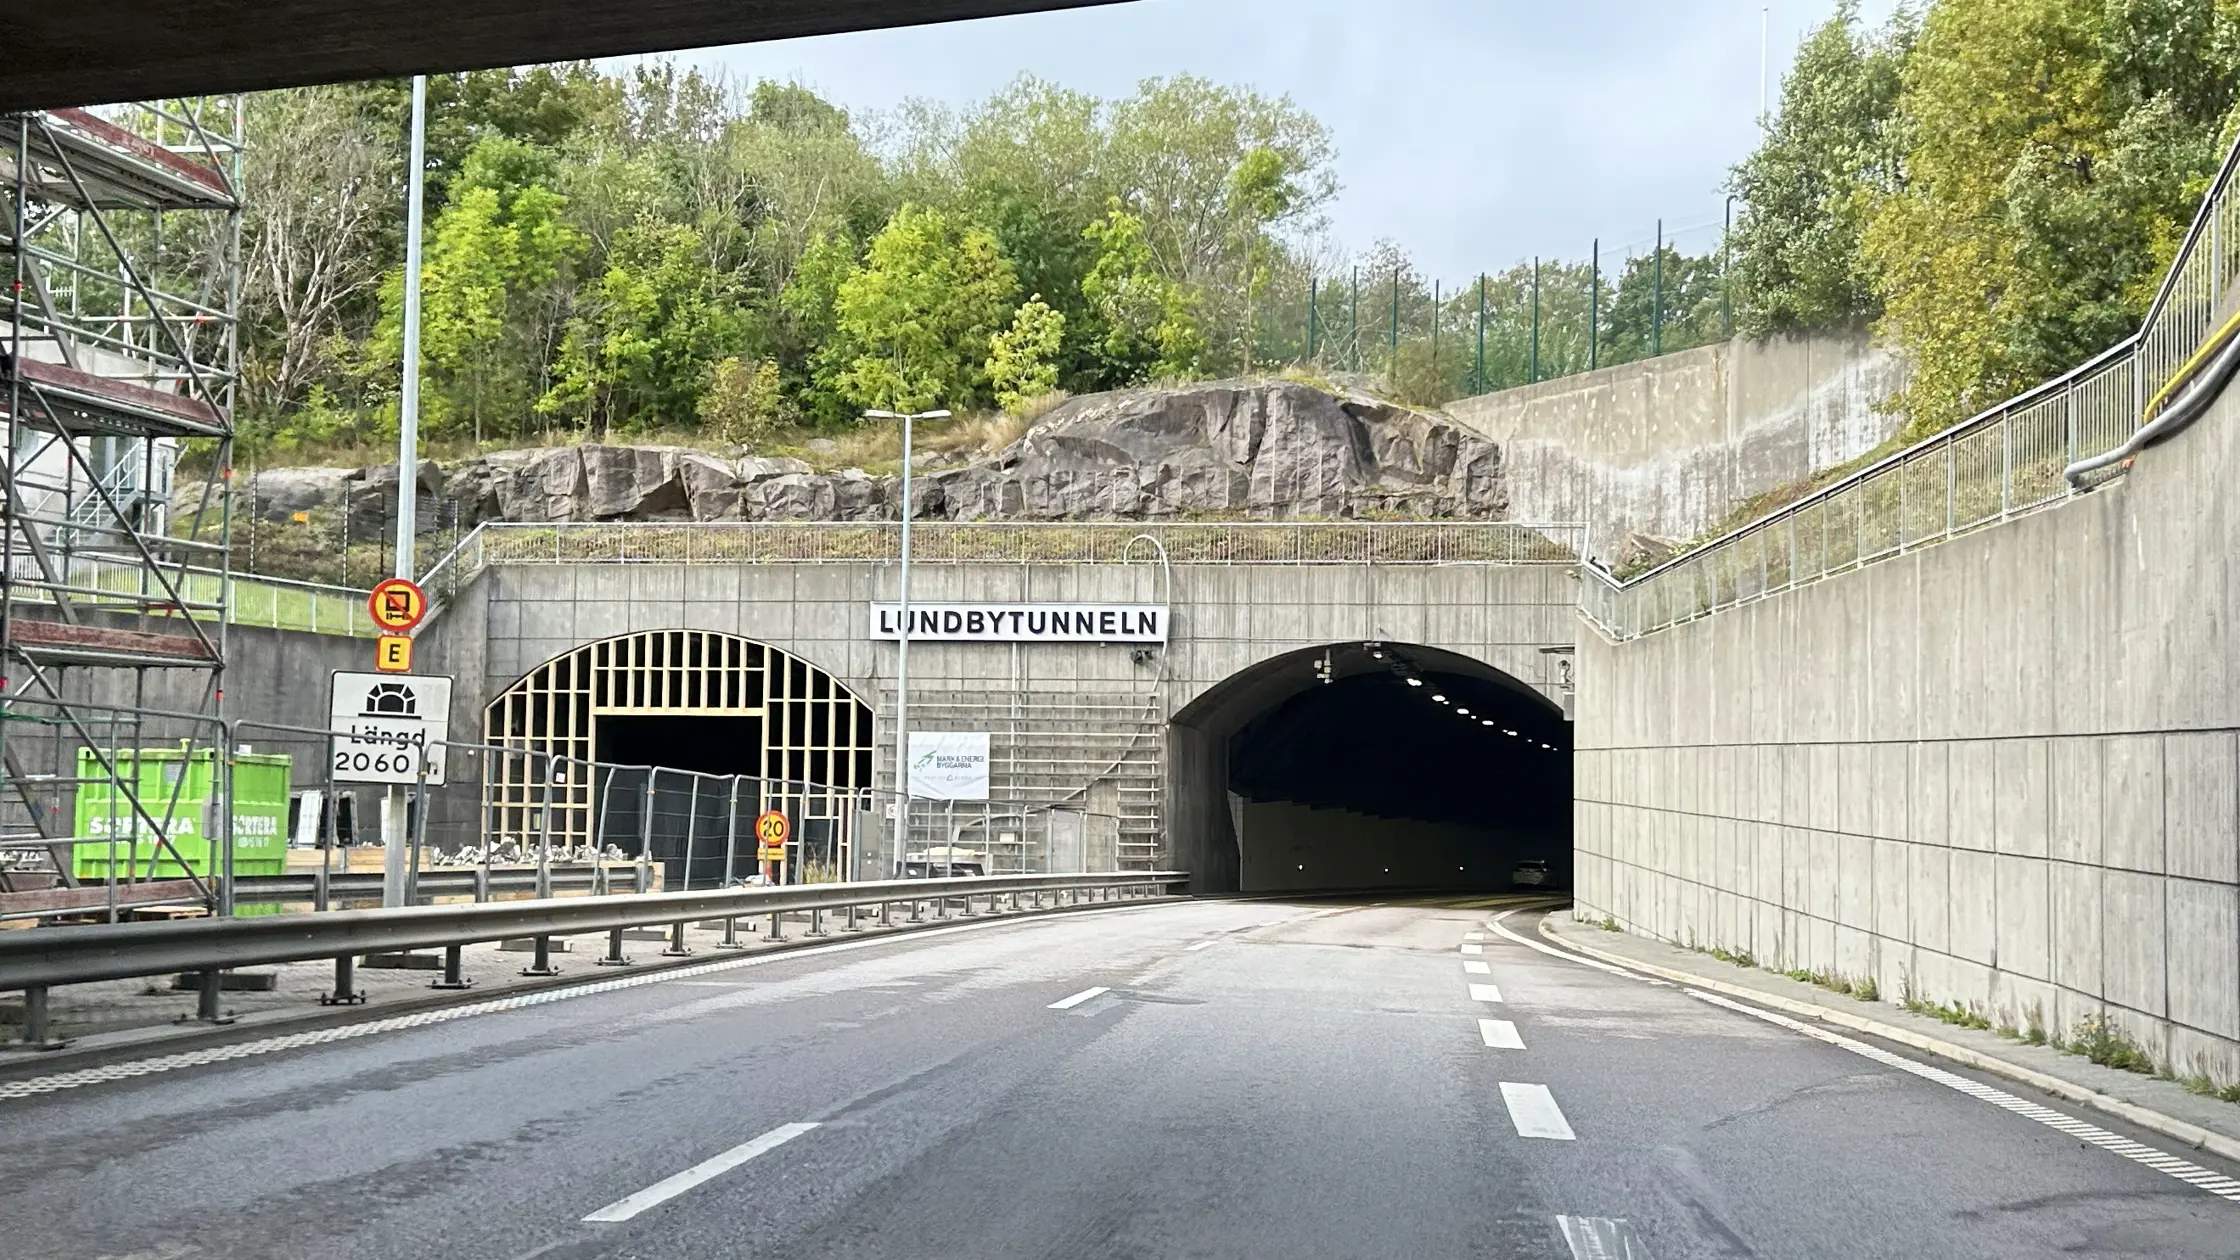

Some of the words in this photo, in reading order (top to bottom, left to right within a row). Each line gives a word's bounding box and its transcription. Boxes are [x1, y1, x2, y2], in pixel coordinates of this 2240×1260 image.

[880, 610, 1157, 635] LUNDBYTUNNELN
[388, 643, 401, 662] E
[351, 725, 425, 750] Längd
[335, 752, 410, 773] 2060
[763, 820, 784, 837] 20
